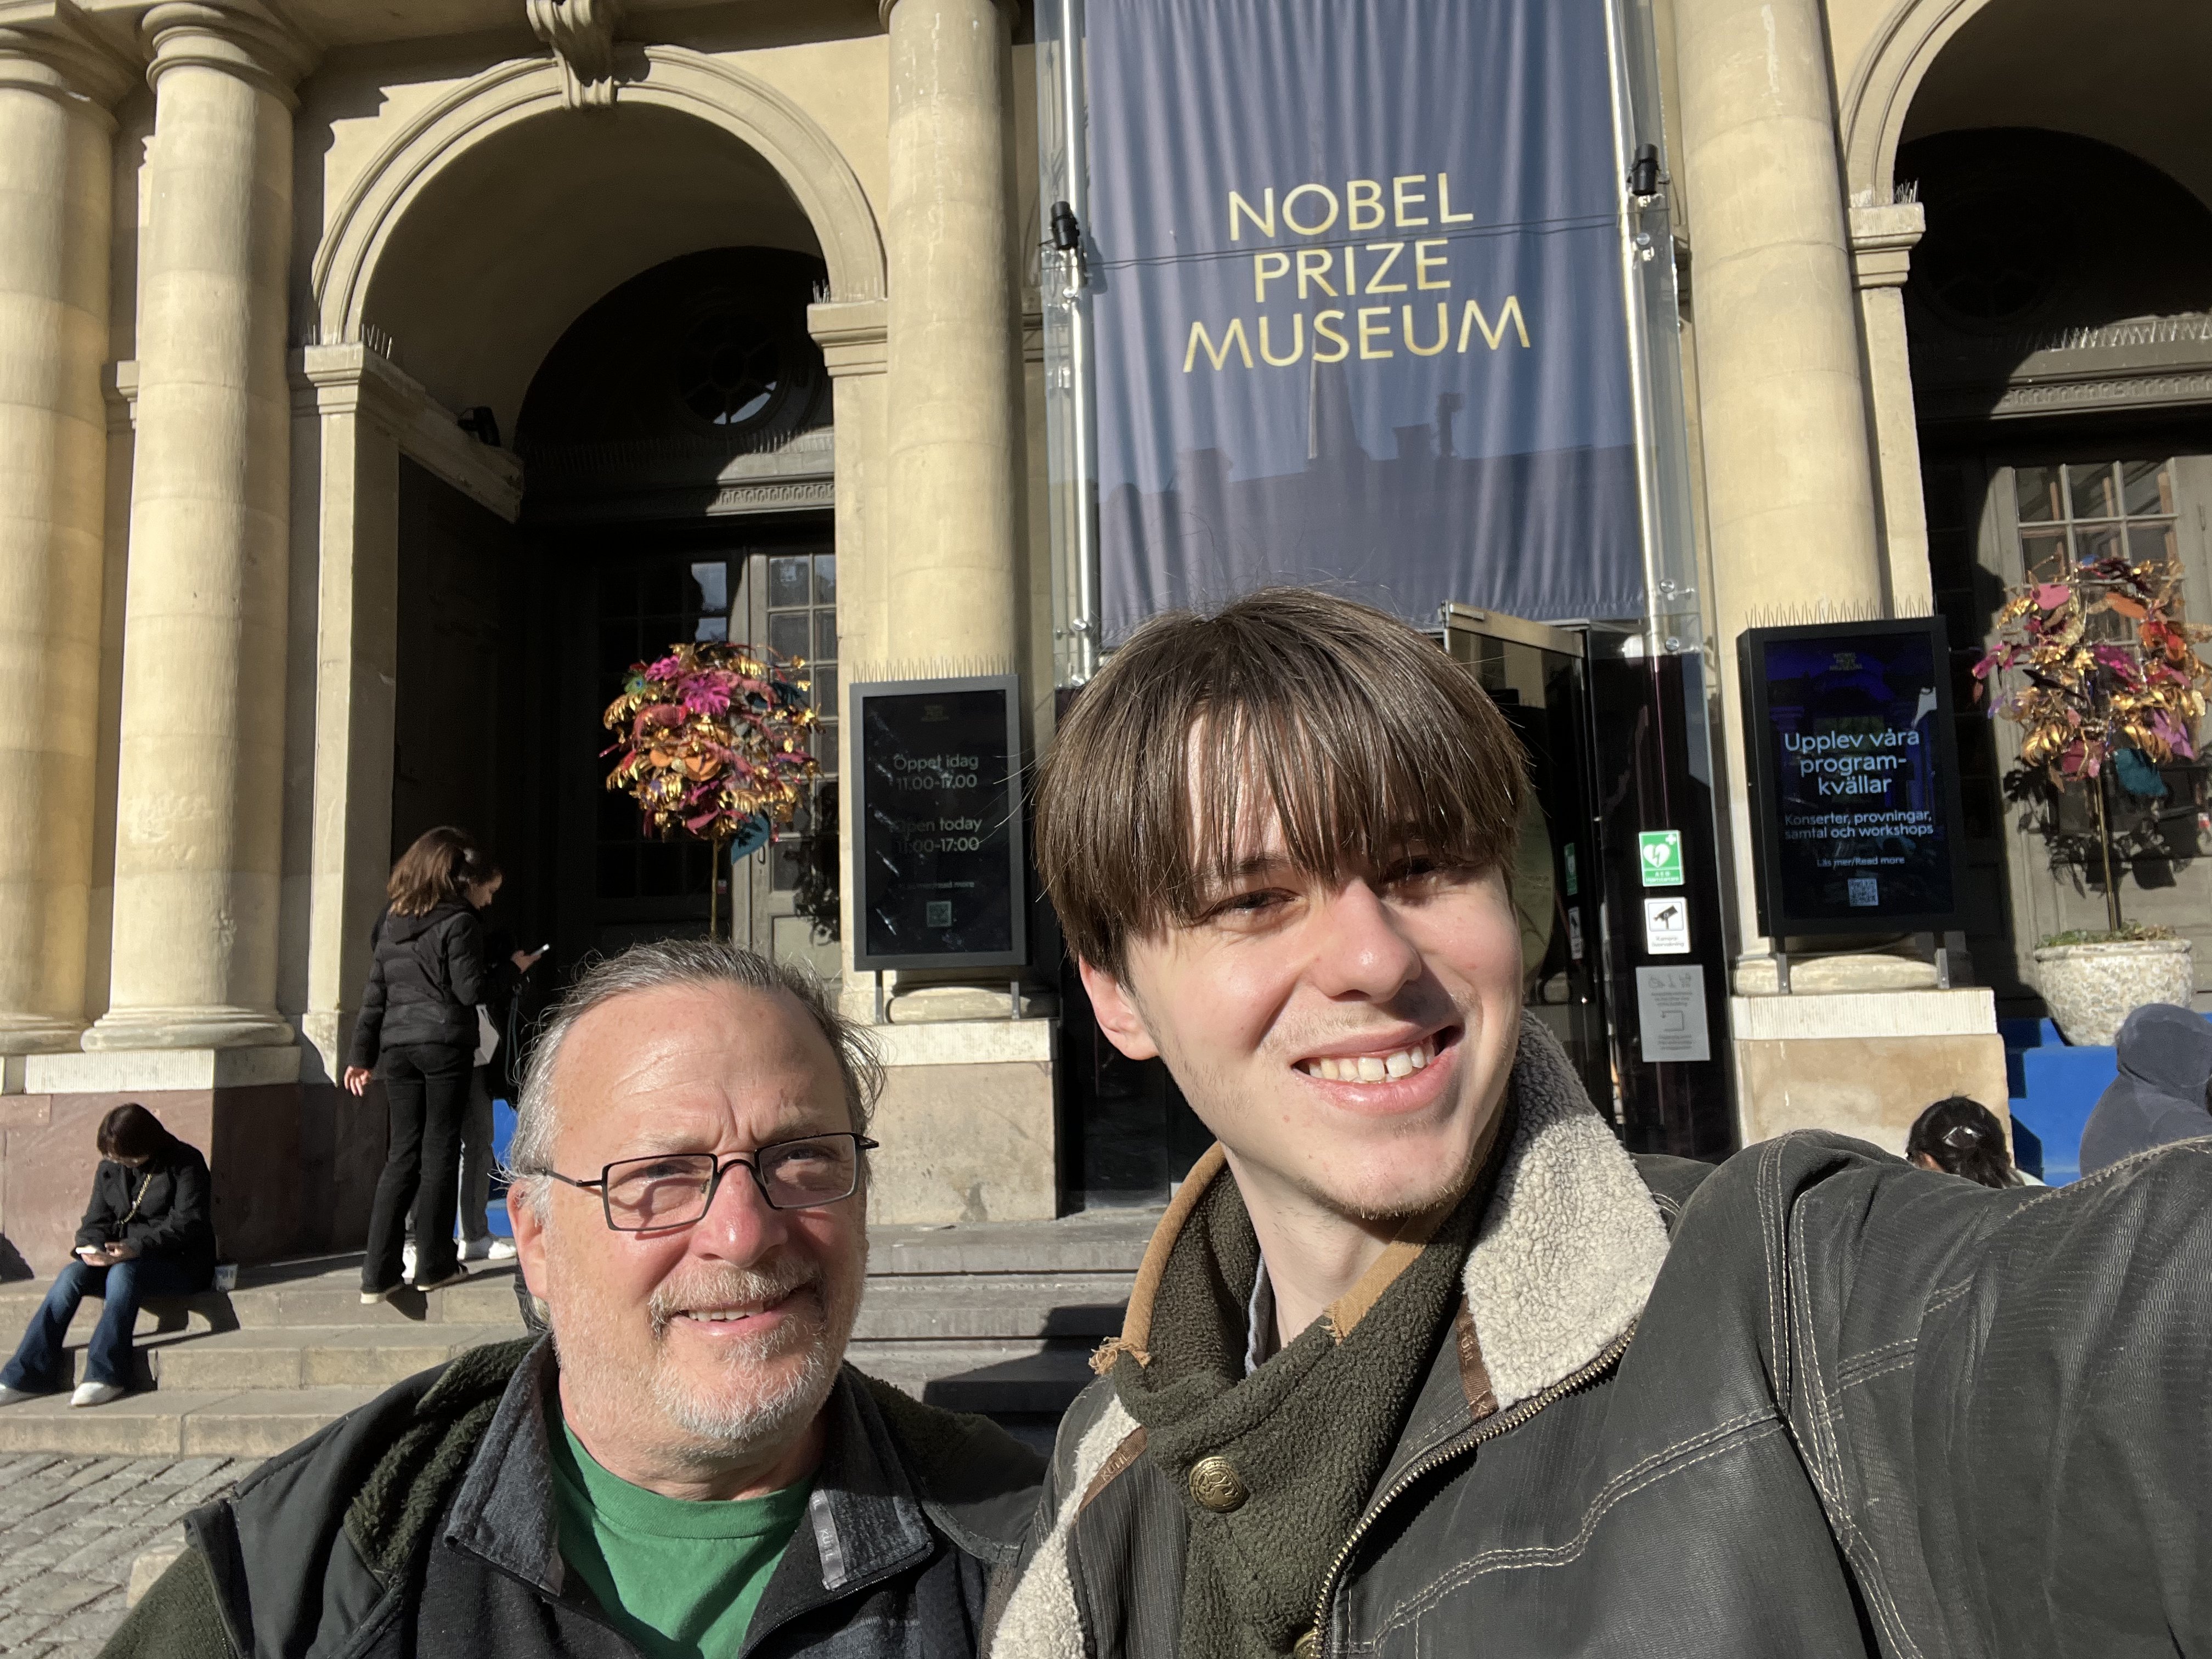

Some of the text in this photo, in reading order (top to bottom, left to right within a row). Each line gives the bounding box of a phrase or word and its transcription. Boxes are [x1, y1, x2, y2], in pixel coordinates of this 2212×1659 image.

[1228, 172, 1474, 241] NOBEL
[1254, 238, 1451, 303] PRIZE
[1182, 295, 1531, 373] MUSEUM
[1784, 727, 1920, 754] Upplev våra
[893, 753, 979, 772] Öppet idag
[1799, 755, 1907, 778] program-
[1818, 774, 1892, 795] kvällar
[940, 815, 983, 833] today
[1785, 810, 1932, 826] Konserter, provningar,
[1785, 822, 1934, 840] samtal och workshops
